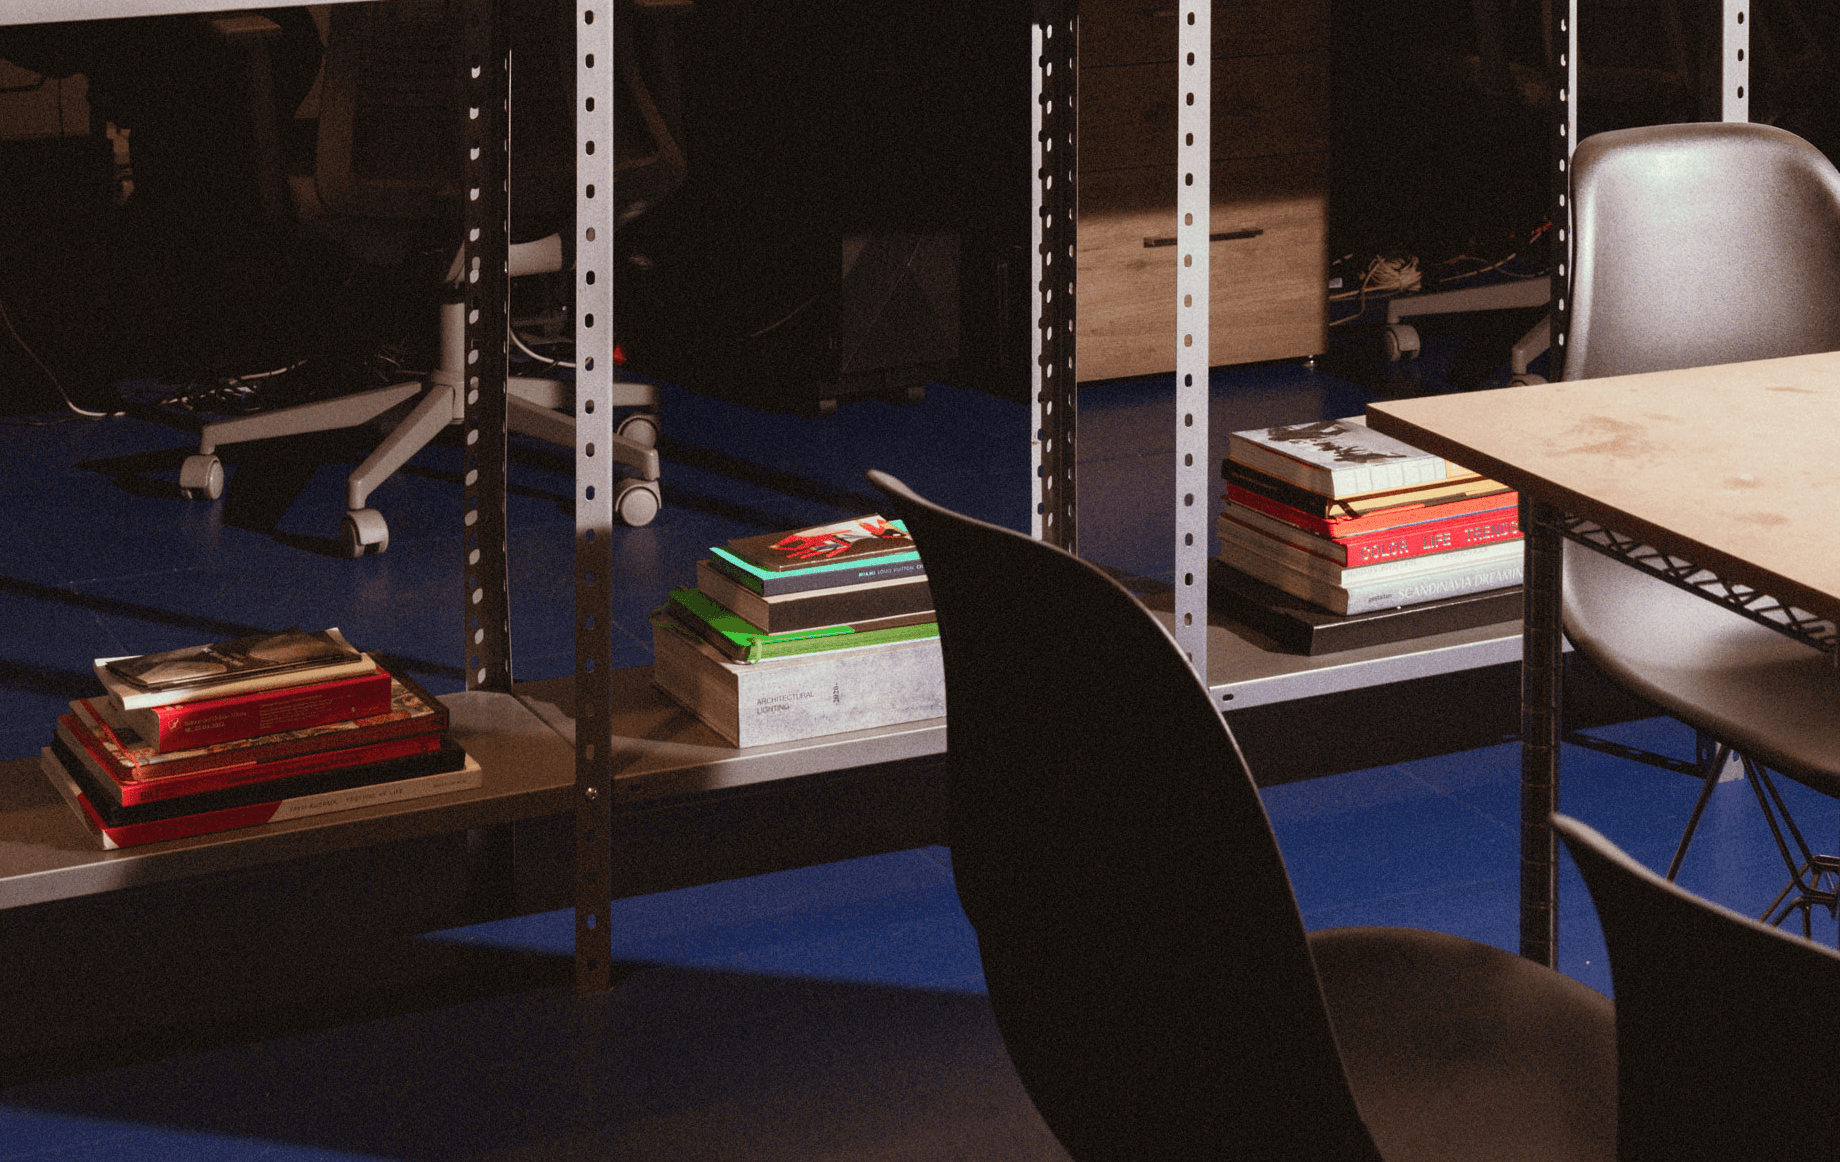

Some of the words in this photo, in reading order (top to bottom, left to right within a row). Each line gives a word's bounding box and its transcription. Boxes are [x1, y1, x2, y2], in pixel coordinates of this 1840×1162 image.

[1360, 540, 1409, 561] COLOR
[1422, 532, 1452, 550] LIFE
[1464, 520, 1519, 542] TRENDS
[1399, 576, 1473, 600] SCANDINAVIA
[1474, 568, 1523, 585] DREAMIN
[756, 691, 815, 705] ARCHITECTURAL
[756, 703, 790, 715] LIGHTING
